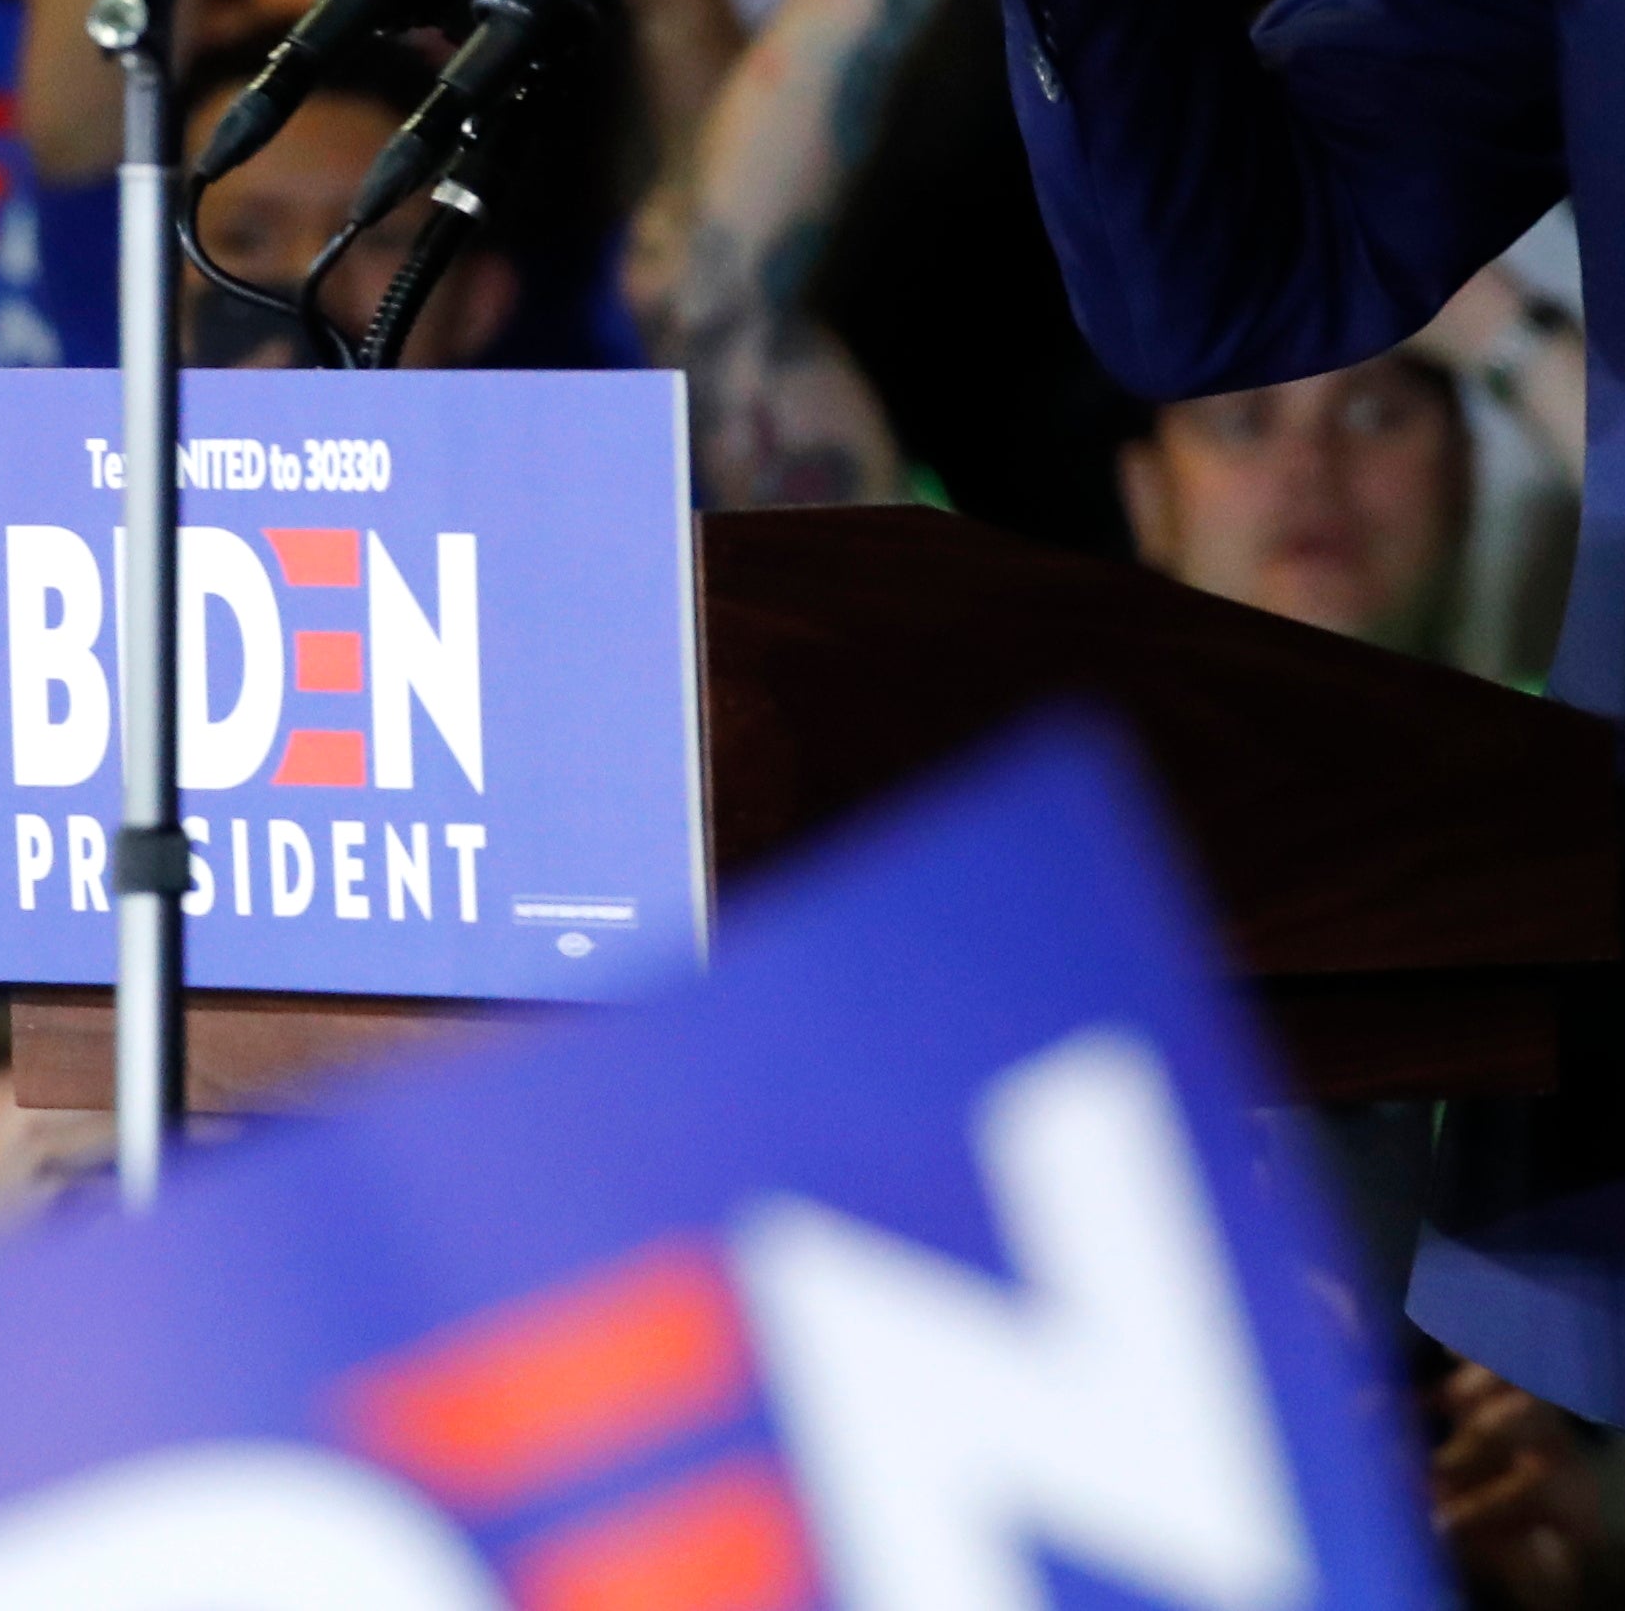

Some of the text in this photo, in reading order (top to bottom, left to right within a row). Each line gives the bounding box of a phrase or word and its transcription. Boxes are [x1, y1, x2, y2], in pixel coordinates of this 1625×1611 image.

[175, 437, 267, 492] NITED
[269, 442, 302, 493] to
[303, 438, 392, 494] 30330
[5, 524, 486, 796] BDEN
[15, 813, 488, 924] PRSIDENT
